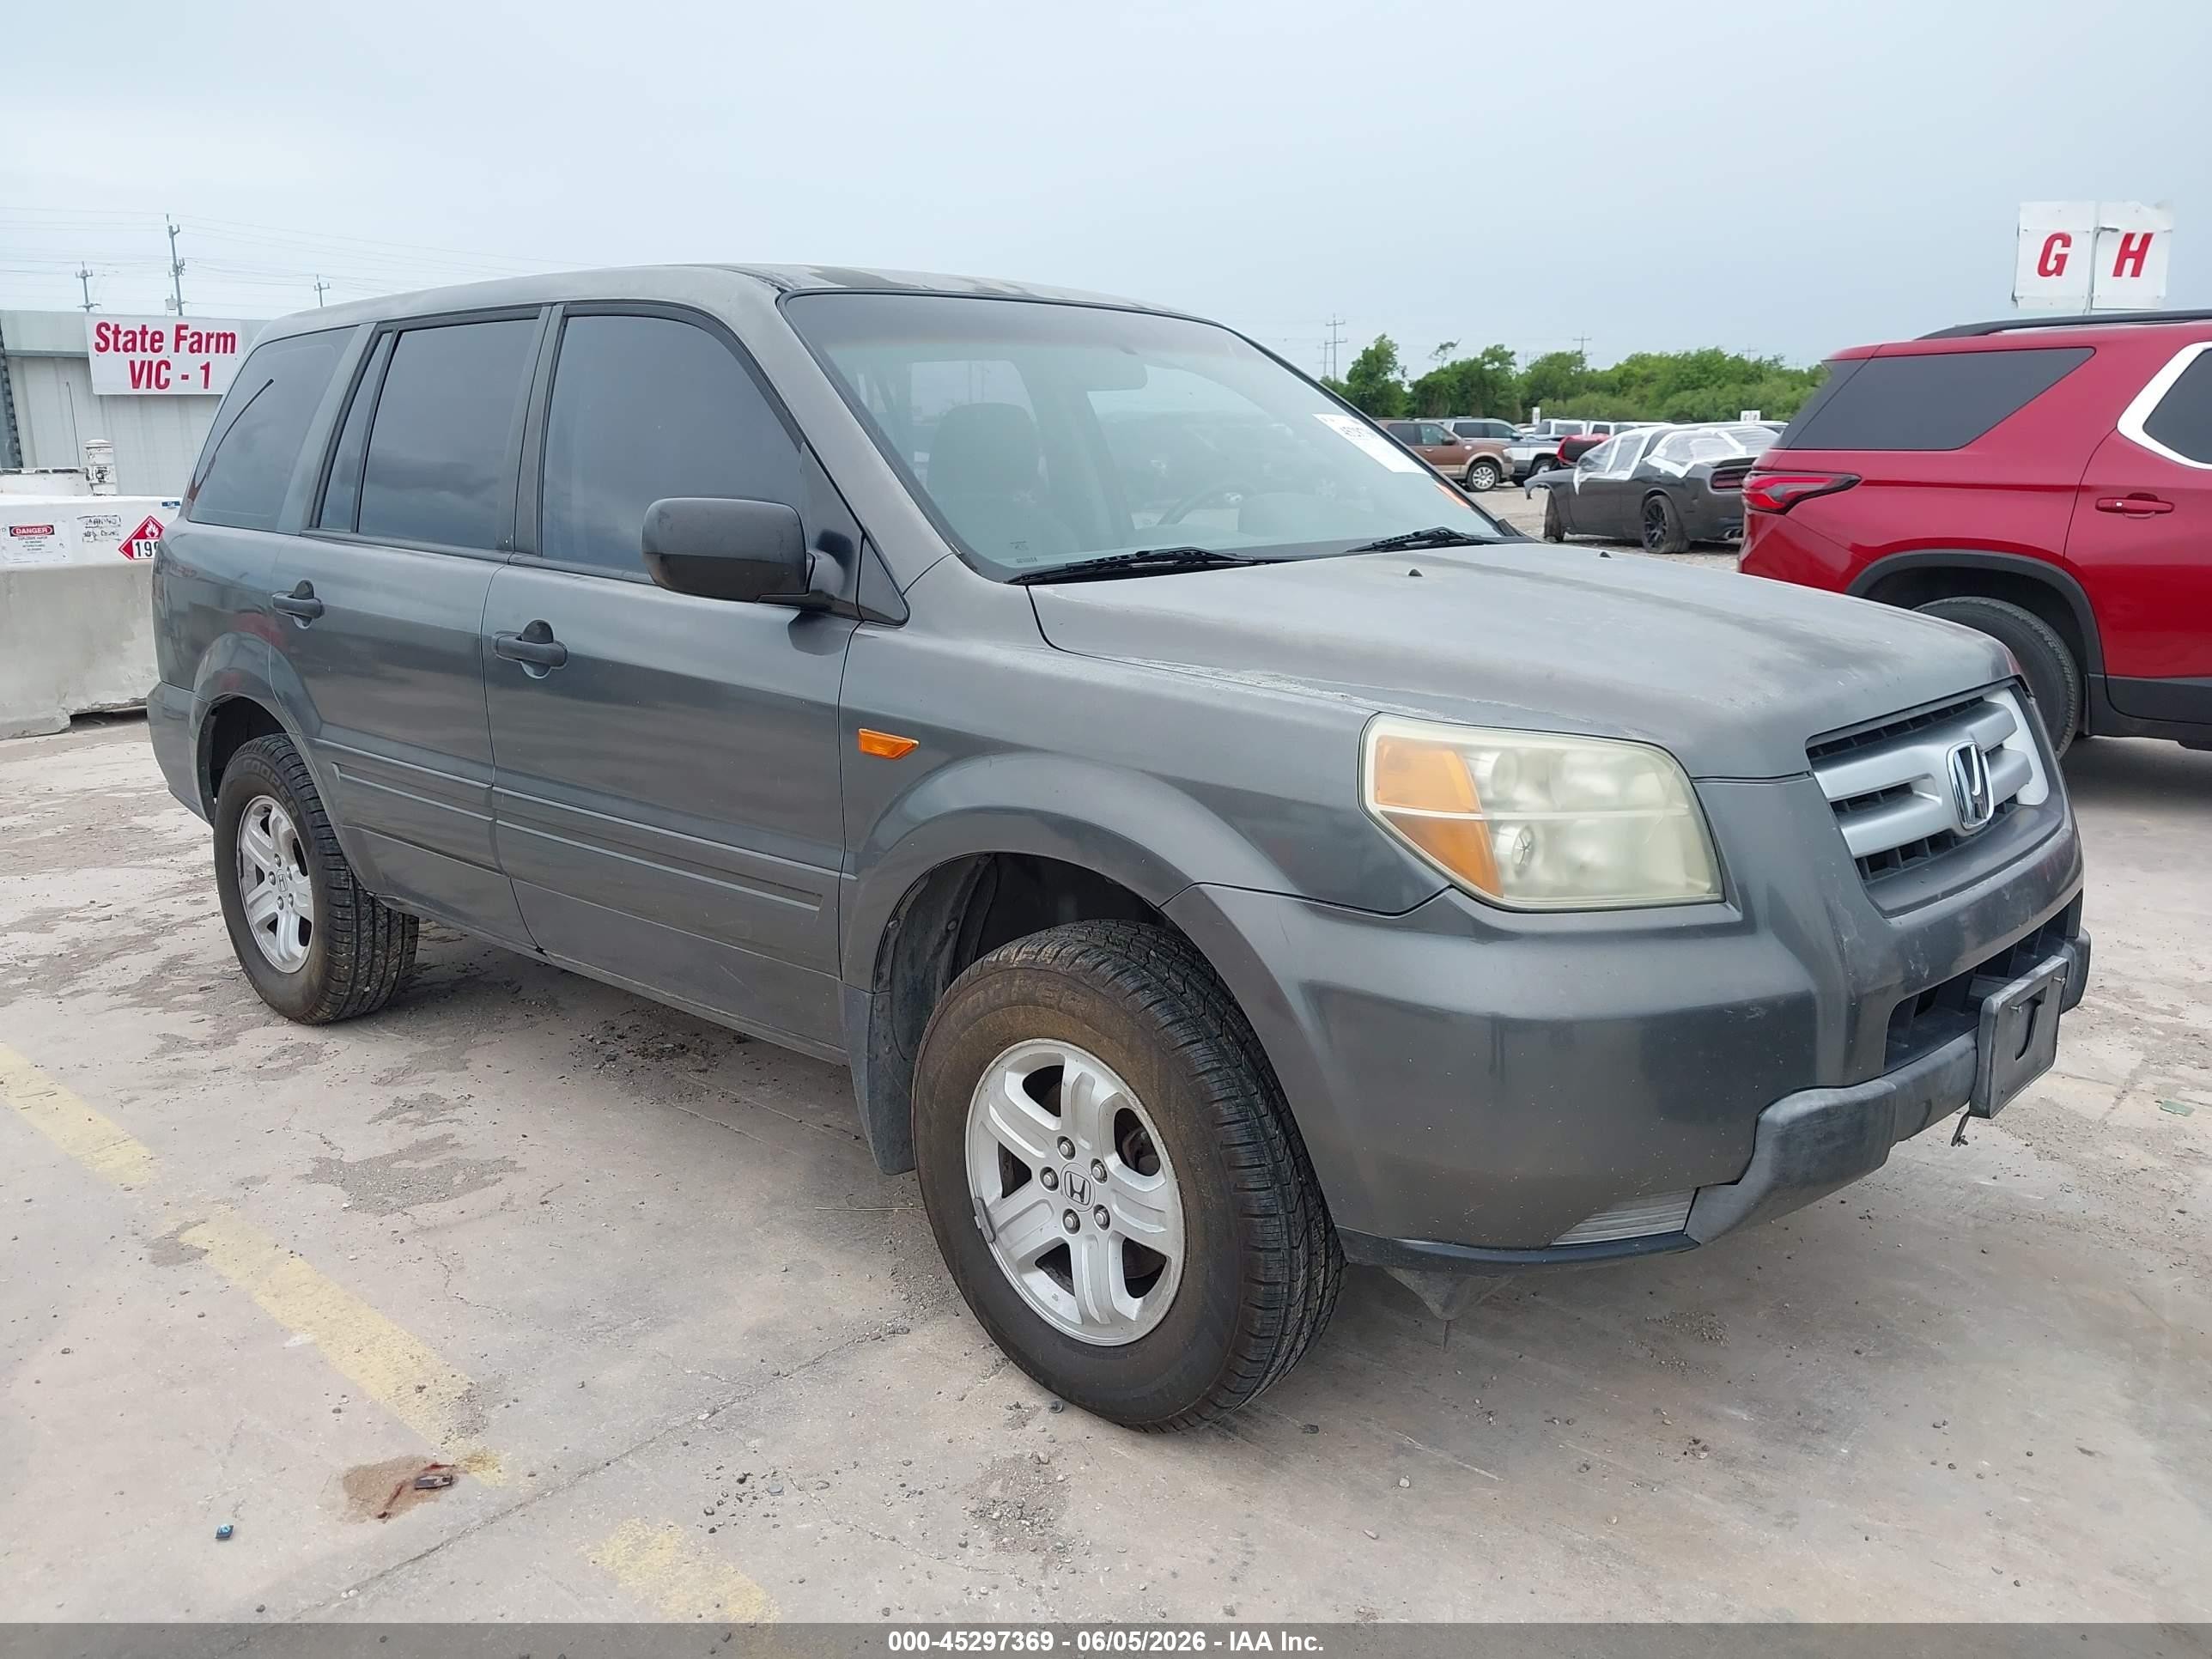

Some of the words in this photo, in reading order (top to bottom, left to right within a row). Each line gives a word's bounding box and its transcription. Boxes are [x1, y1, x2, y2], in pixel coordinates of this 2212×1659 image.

[2037, 232, 2072, 277] G
[2112, 233, 2154, 277] H
[94, 321, 164, 353] State
[173, 324, 236, 354] Farm
[129, 360, 171, 390] VIC
[199, 361, 210, 389] 1
